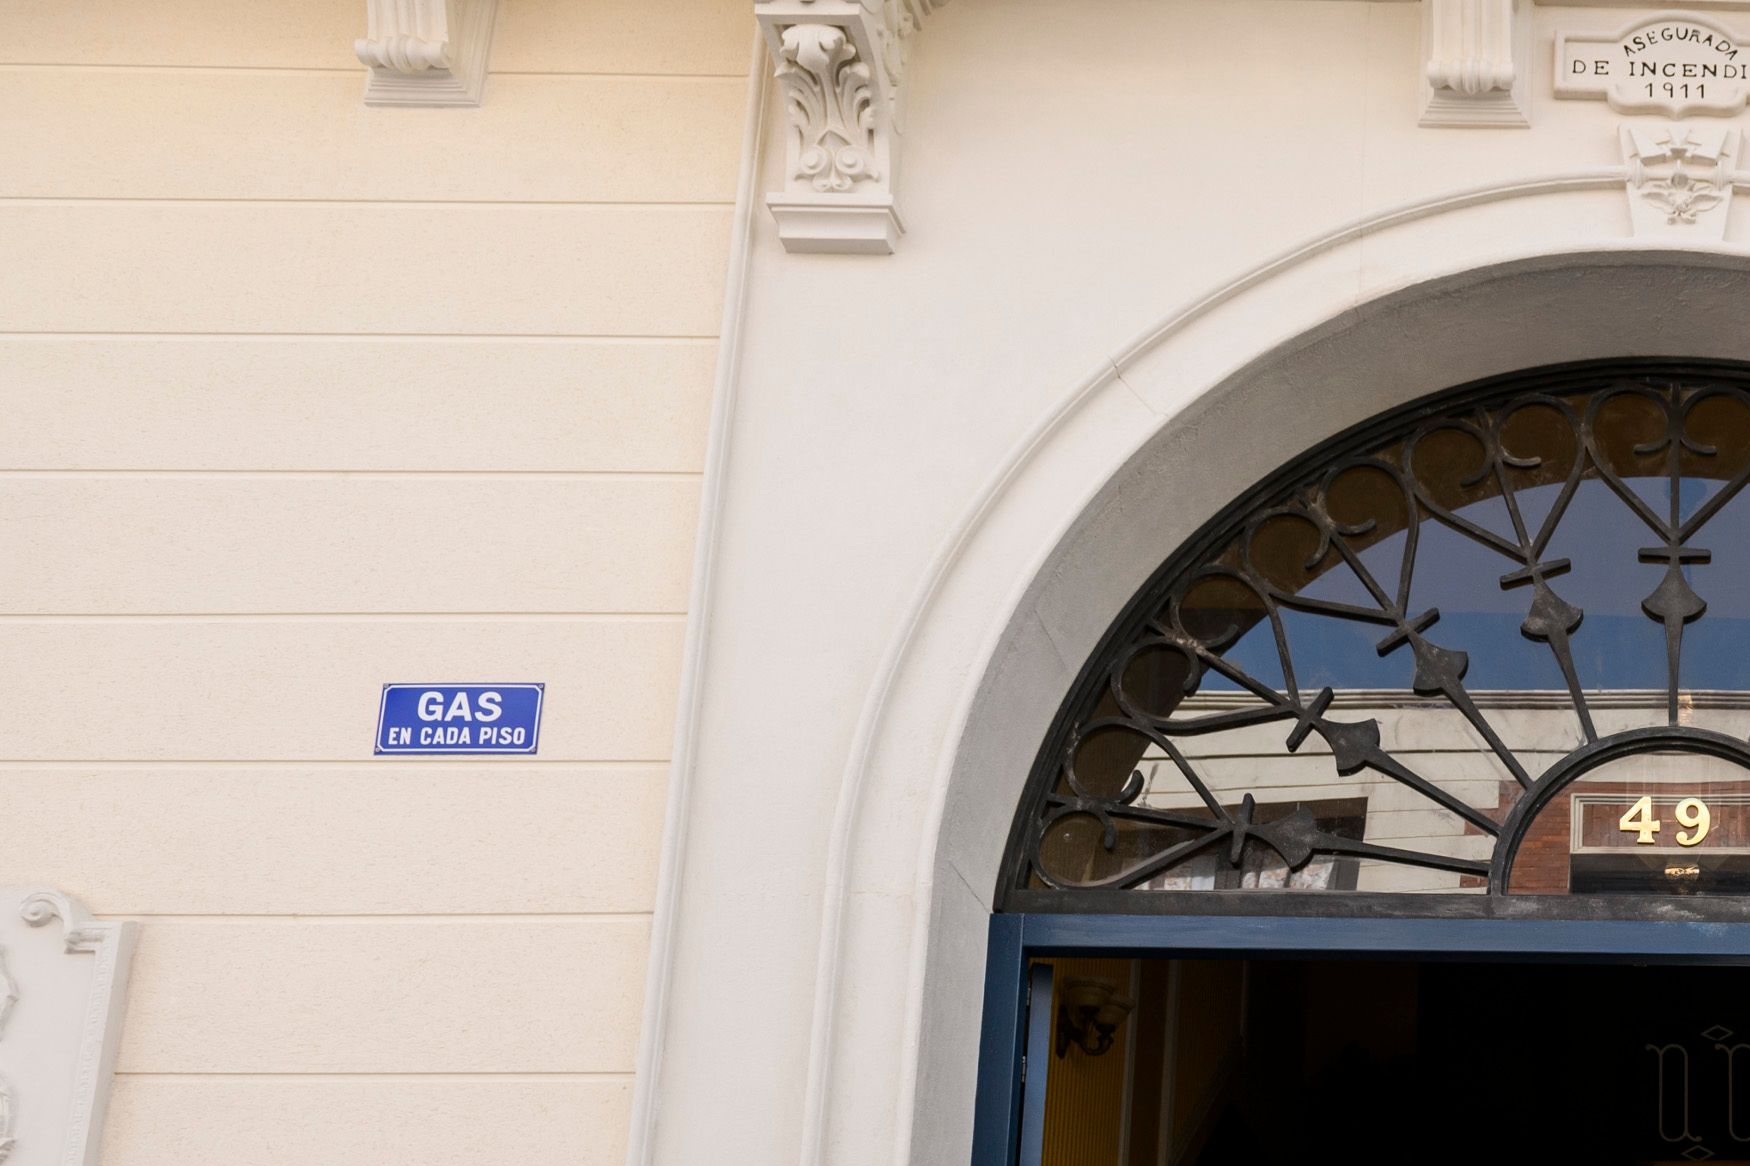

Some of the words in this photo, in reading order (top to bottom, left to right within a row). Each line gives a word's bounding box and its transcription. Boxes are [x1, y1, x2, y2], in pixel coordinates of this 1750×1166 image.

[1623, 27, 1738, 60] ASEGURADA
[1572, 59, 1609, 75] DE
[1644, 82, 1706, 99] 1911
[417, 691, 503, 722] GAS
[388, 727, 412, 745] EN
[420, 727, 471, 745] CADA
[478, 727, 526, 745] PISO
[1619, 796, 1711, 847] 49
